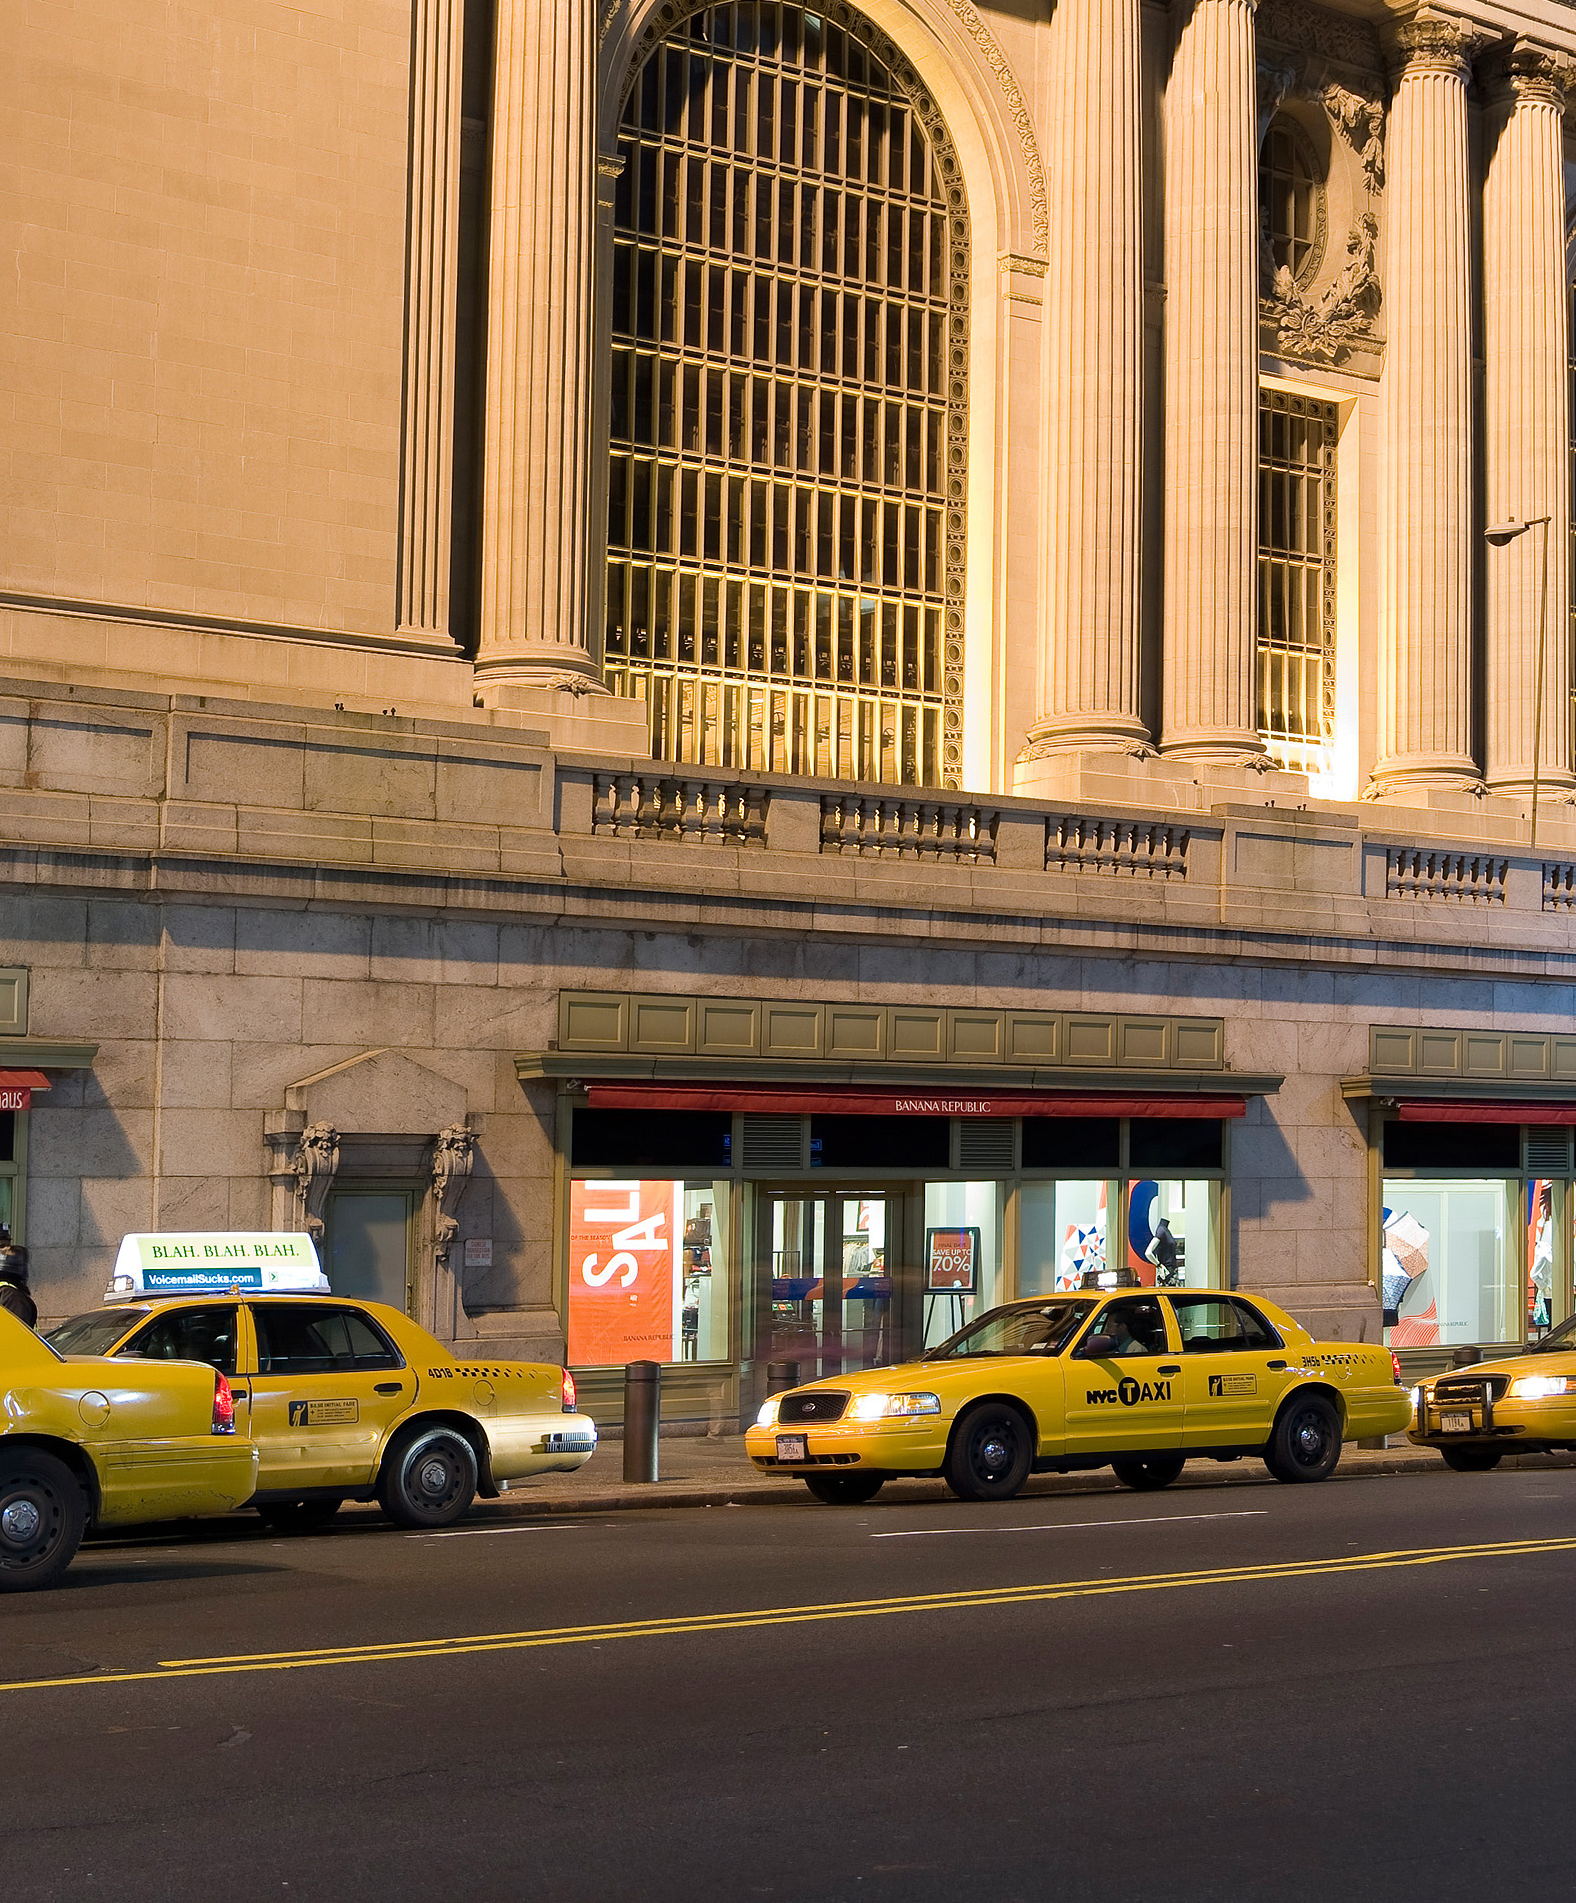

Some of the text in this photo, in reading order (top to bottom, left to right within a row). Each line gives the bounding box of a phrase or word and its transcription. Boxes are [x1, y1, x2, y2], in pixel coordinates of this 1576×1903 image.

[895, 1100, 991, 1112] BANANA REPUBLIC
[152, 1244, 300, 1258] BLAH. BLAH. BLAH.
[932, 1256, 971, 1272] 70%
[149, 1272, 254, 1285] VoicemailSucks.com
[623, 1334, 647, 1342] BANANA
[1086, 1378, 1171, 1405] NYC TAXI
